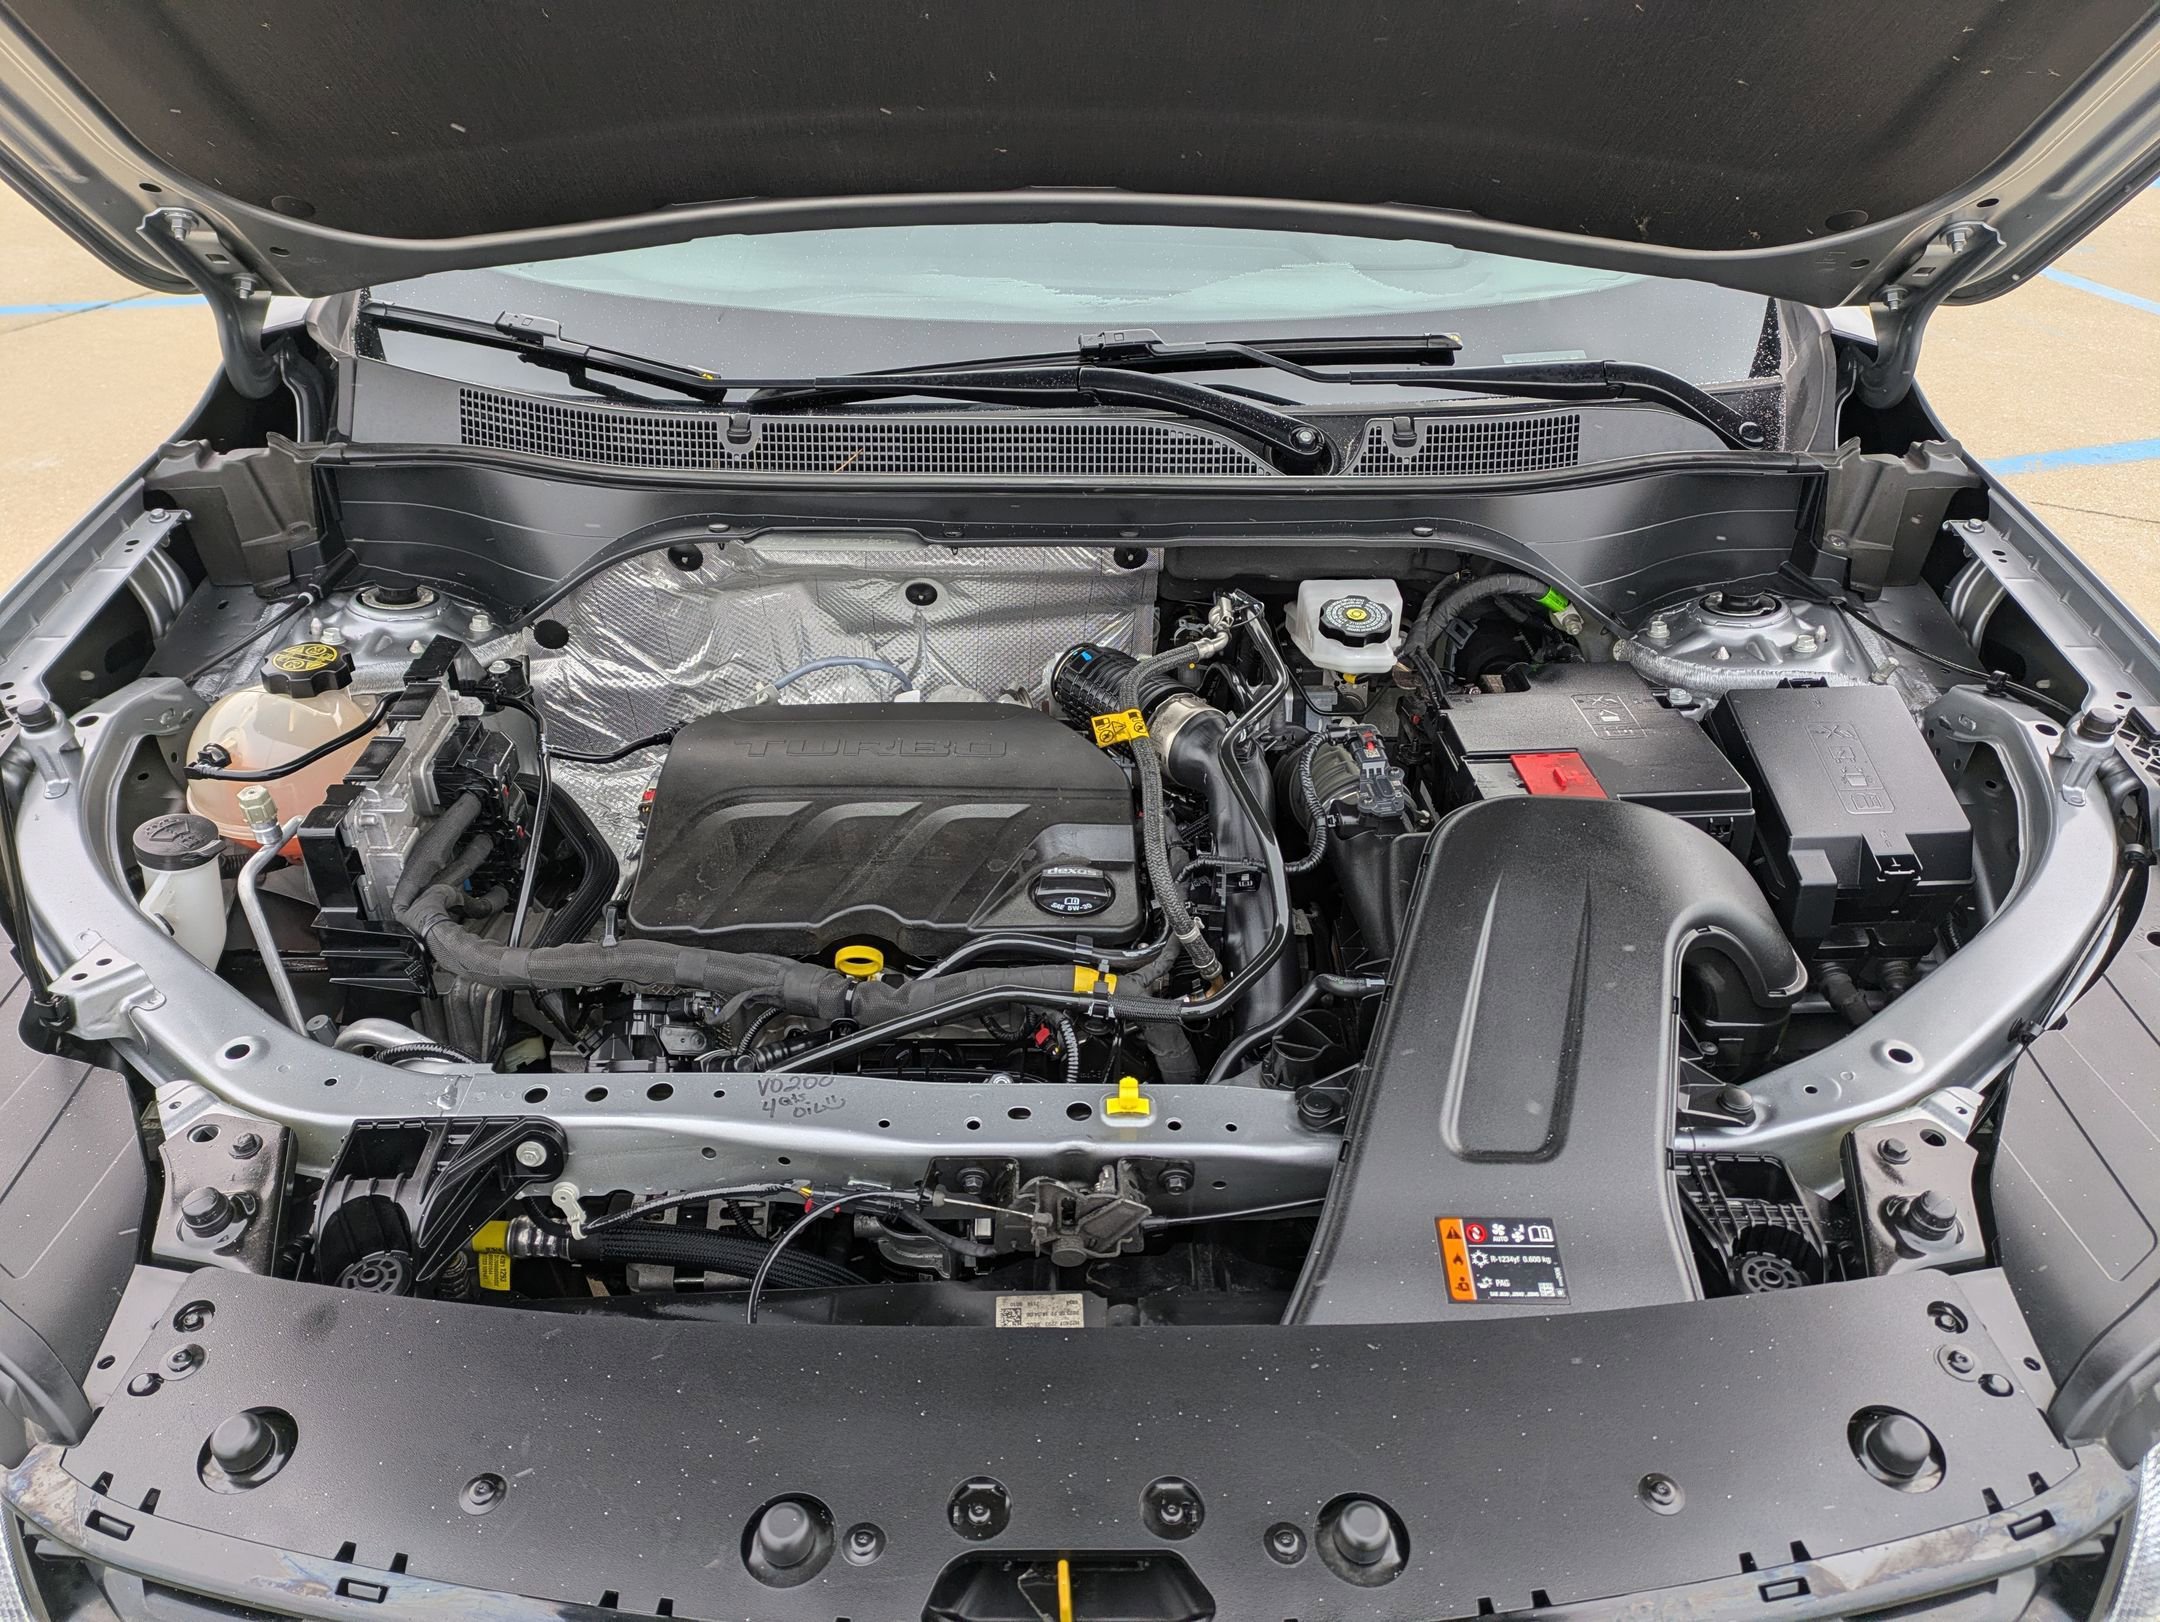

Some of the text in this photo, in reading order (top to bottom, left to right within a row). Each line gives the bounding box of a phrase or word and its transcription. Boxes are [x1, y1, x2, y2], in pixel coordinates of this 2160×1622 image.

[733, 737, 1007, 758] TURBO
[1051, 902, 1065, 911] SAE
[762, 1098, 776, 1118] 4
[1541, 1256, 1552, 1264] kg
